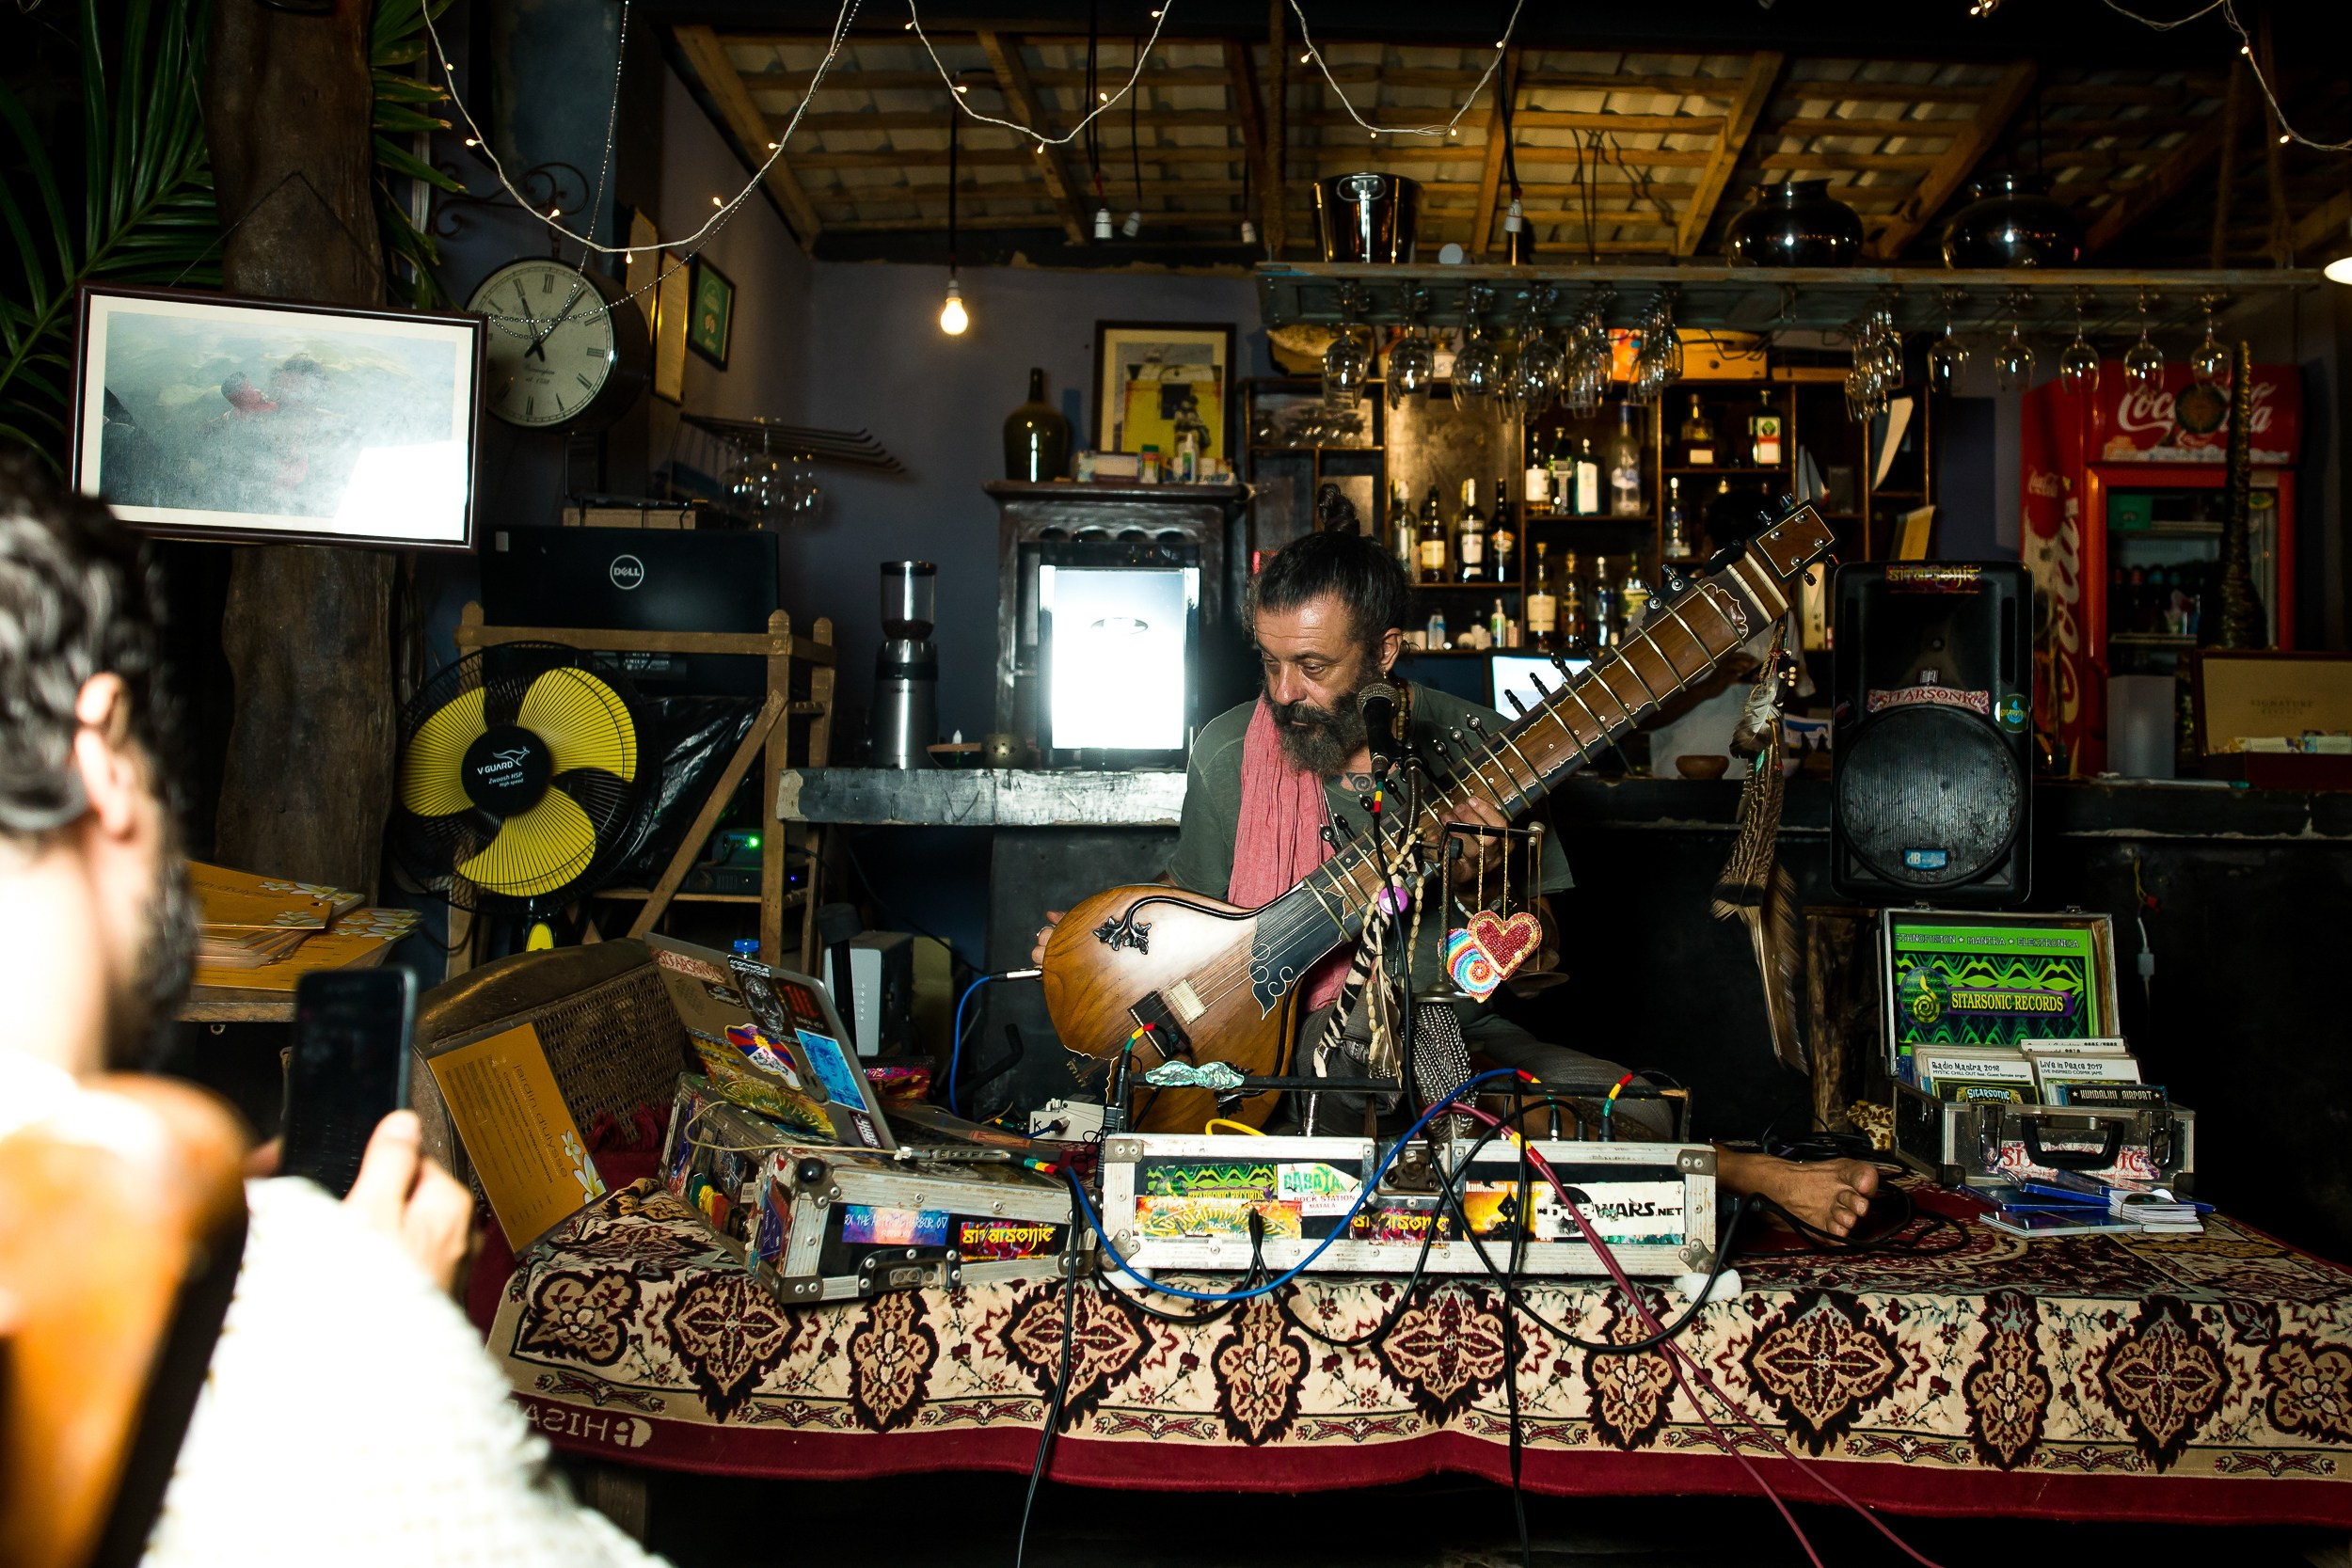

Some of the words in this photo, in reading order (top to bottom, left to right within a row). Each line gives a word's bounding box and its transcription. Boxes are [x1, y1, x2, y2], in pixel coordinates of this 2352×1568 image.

[613, 566, 641, 578] DELL
[1967, 936, 2005, 946] MANTRA
[1951, 992, 2012, 1011] SITARSONIC
[2014, 995, 2064, 1012] RECORDS
[1931, 1061, 1953, 1070] Radio
[1955, 1062, 1982, 1072] Mantra
[2065, 1062, 2085, 1070] Peace
[1967, 1088, 2010, 1100] SITARSONIC
[2080, 1090, 2117, 1099] KUNDALINI
[2122, 1091, 2152, 1100] AIRPORT
[962, 1223, 1055, 1252] sitarsonic
